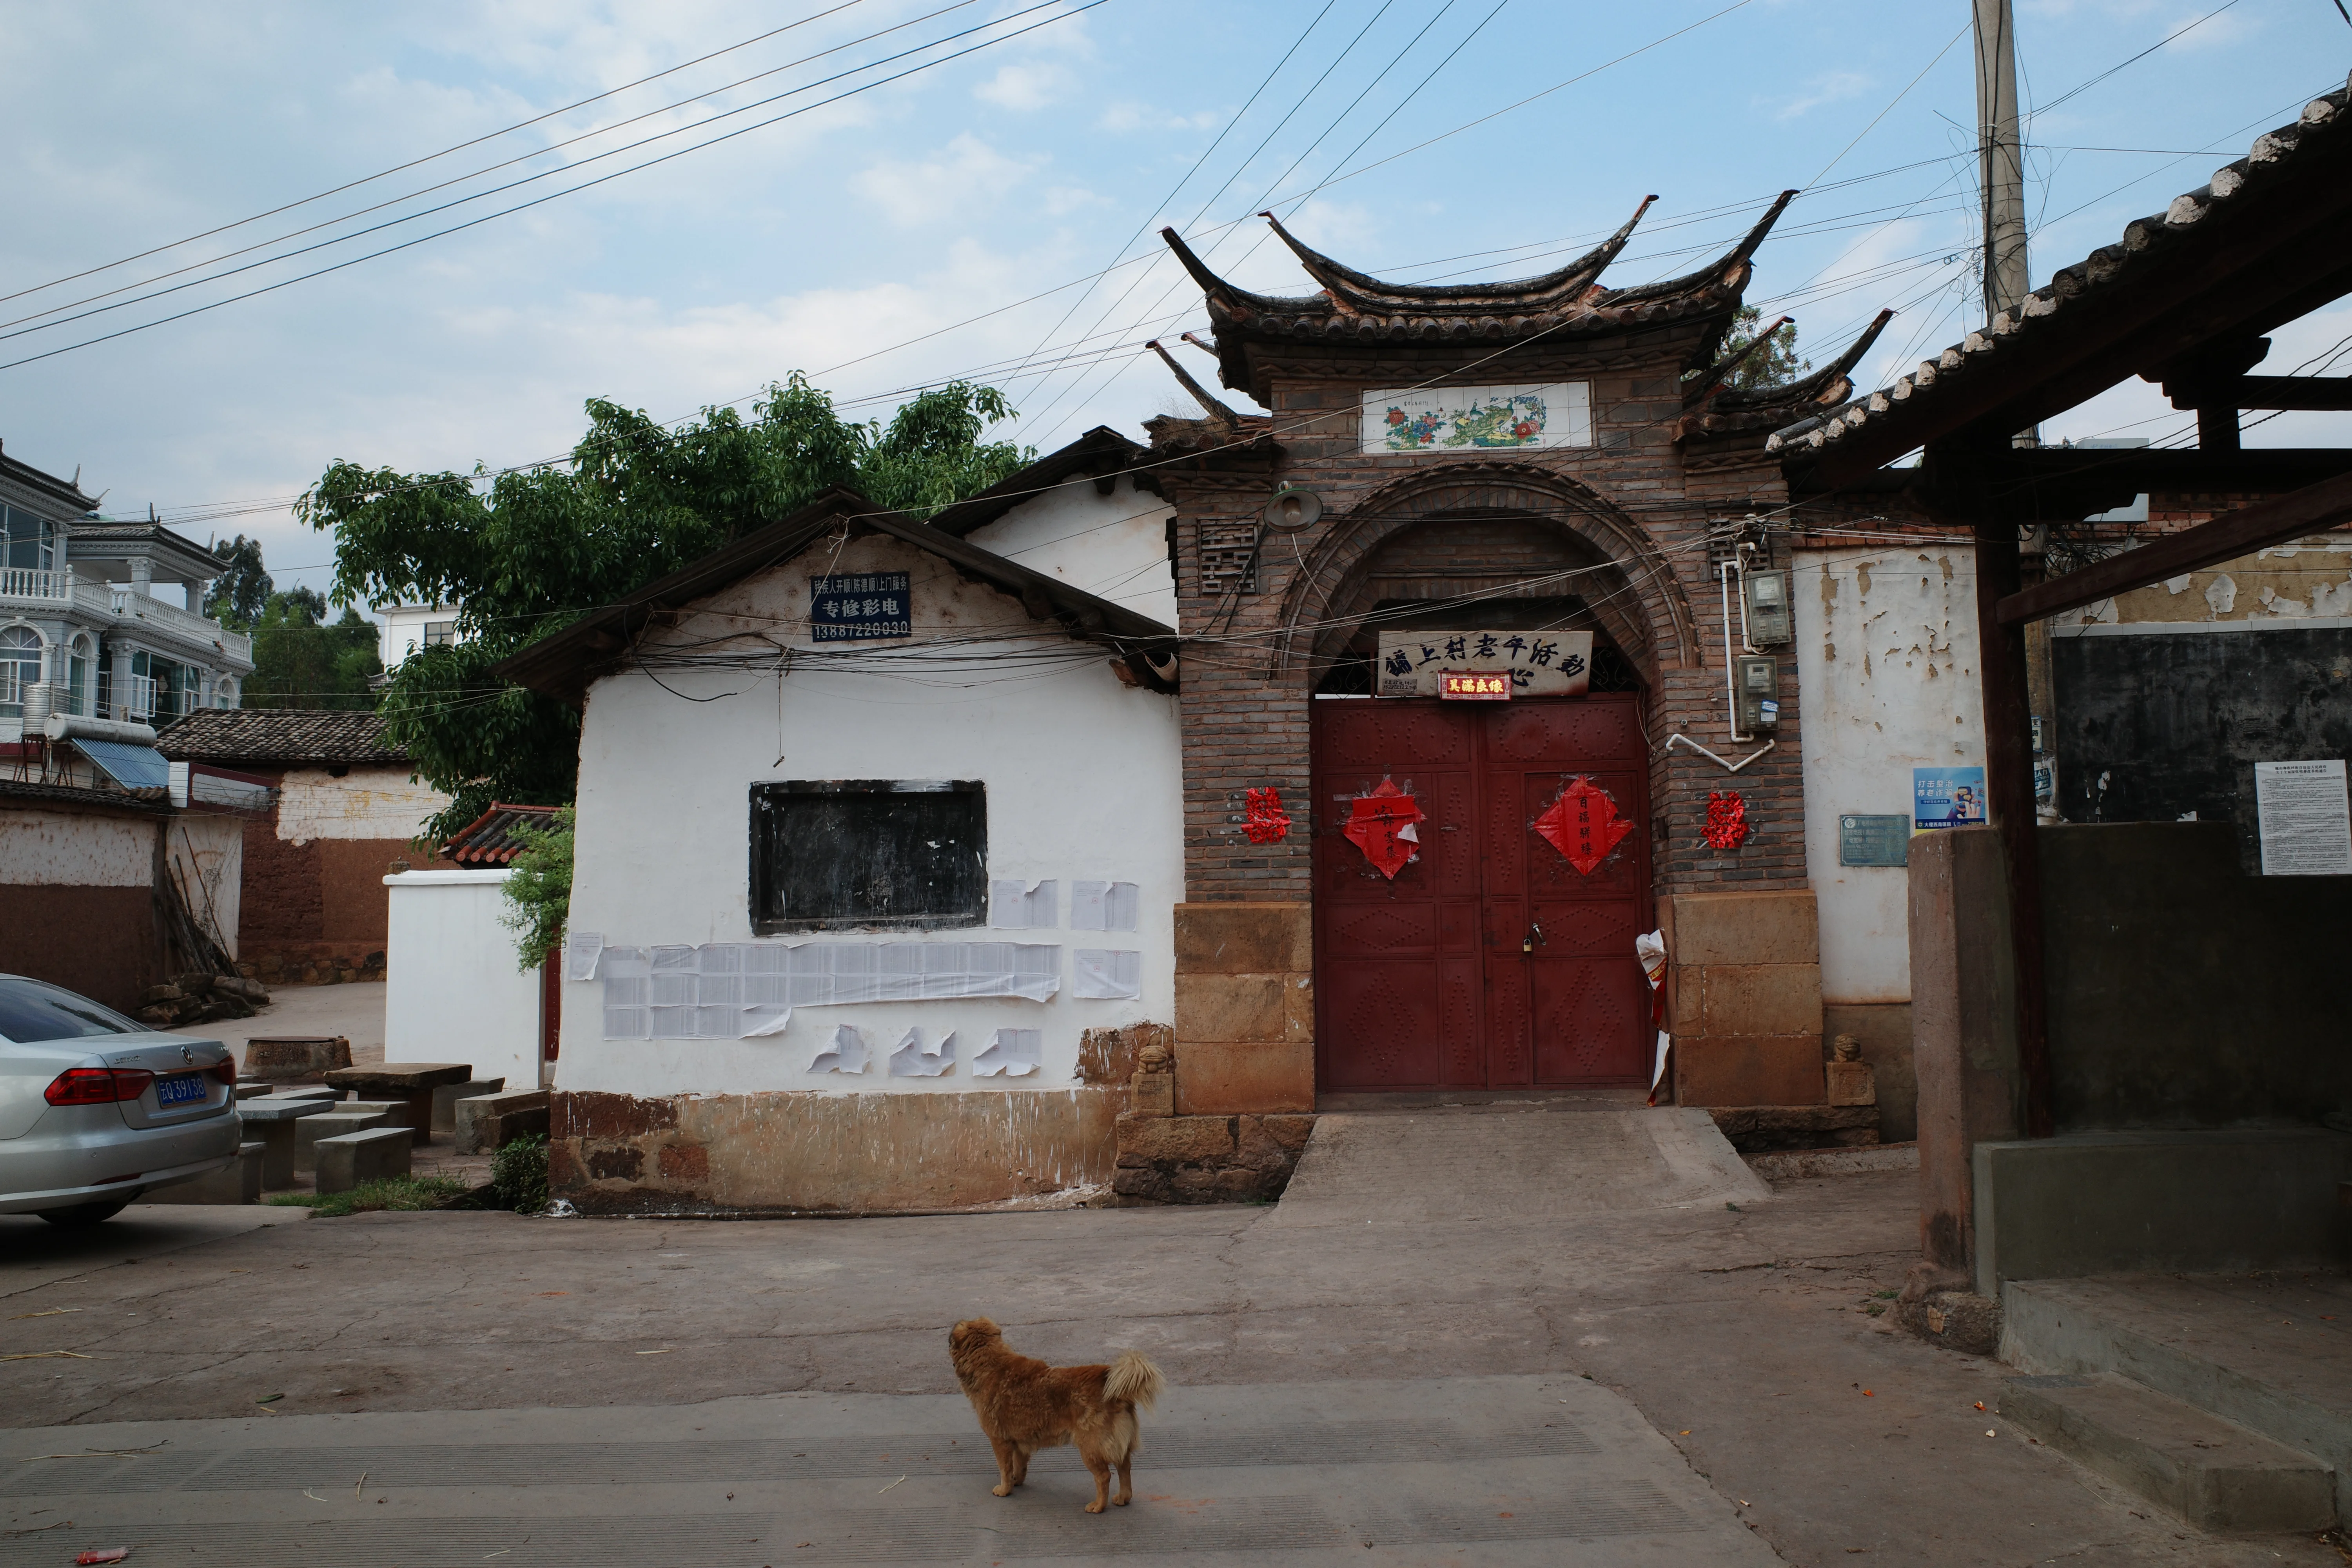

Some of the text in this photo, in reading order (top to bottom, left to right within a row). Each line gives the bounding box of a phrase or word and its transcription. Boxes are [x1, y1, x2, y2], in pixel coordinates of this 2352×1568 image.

[822, 598, 900, 618] 专修彩电
[815, 621, 908, 639] 13887220030
[1917, 779, 1953, 788] 打击整治
[1916, 788, 1953, 797] 养老诈骗
